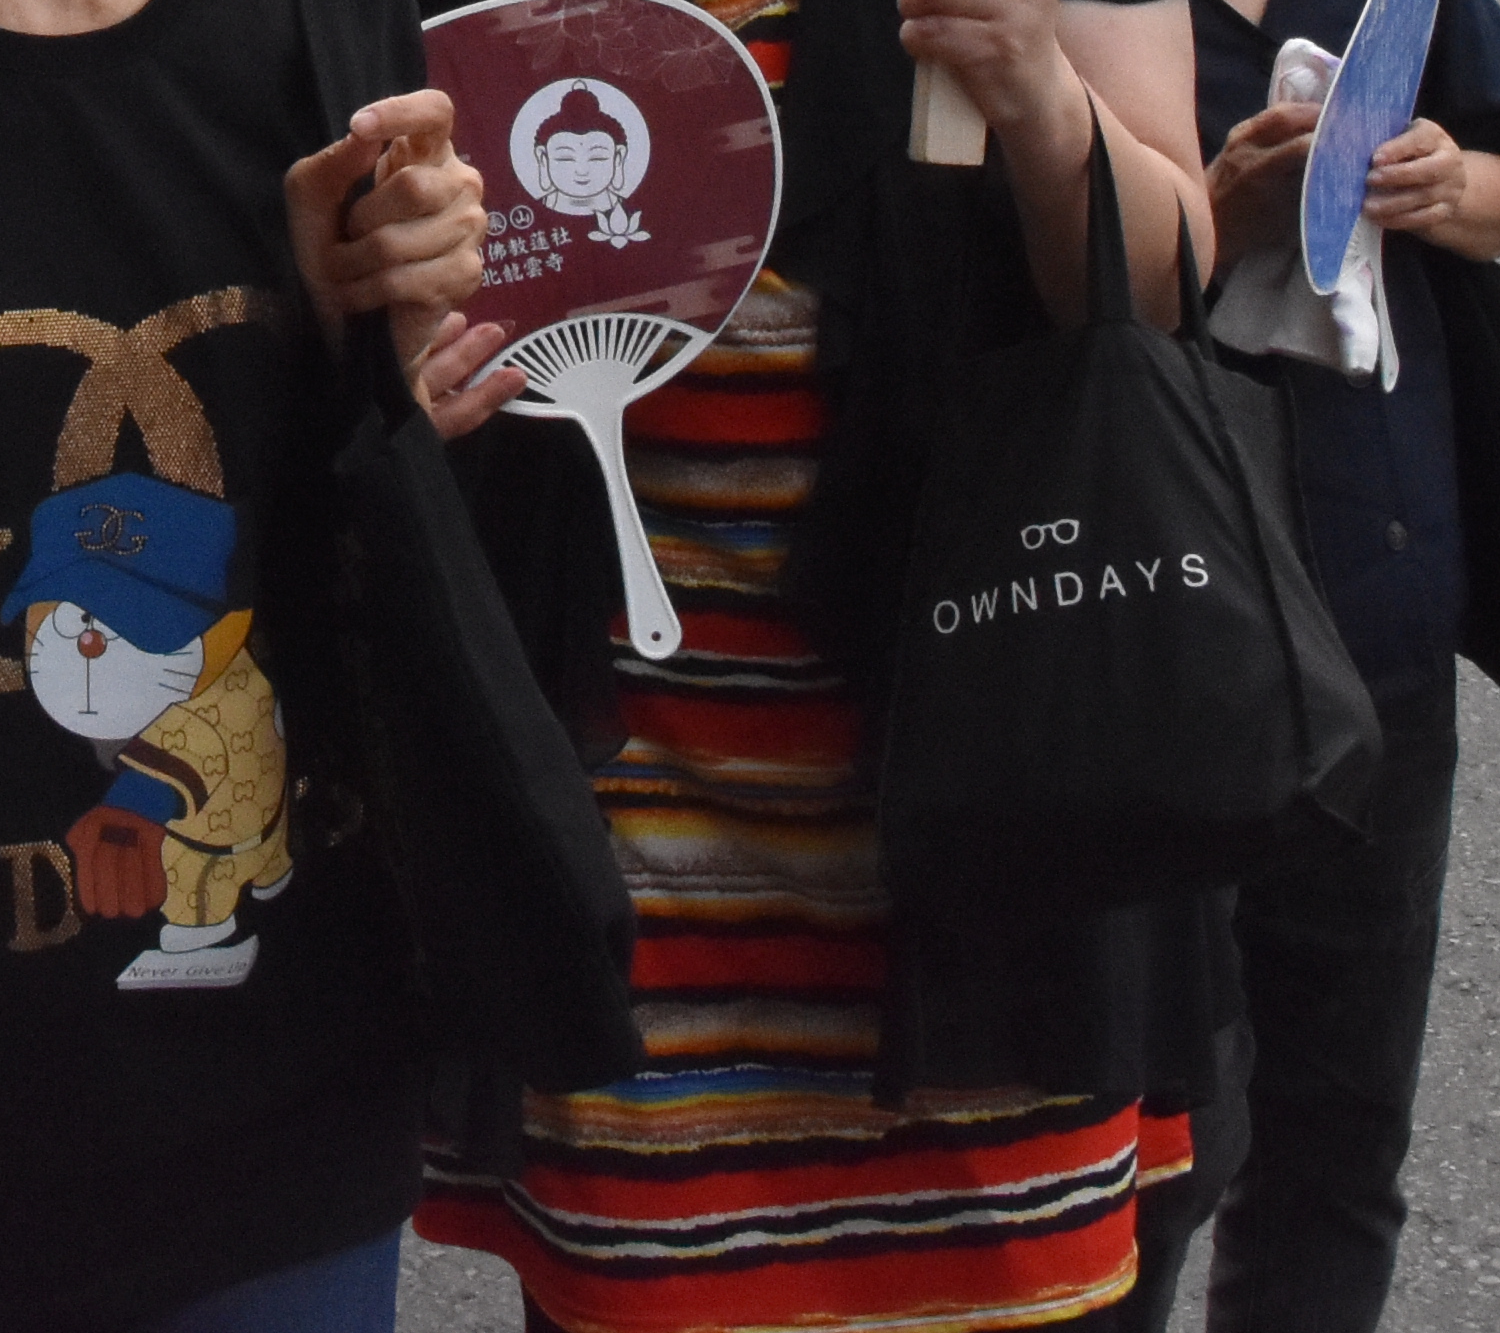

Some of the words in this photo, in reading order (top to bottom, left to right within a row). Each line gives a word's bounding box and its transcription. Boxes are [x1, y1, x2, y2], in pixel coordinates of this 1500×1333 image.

[477, 225, 573, 265] 佛教蓮社
[933, 552, 1210, 636] OWNDAYS
